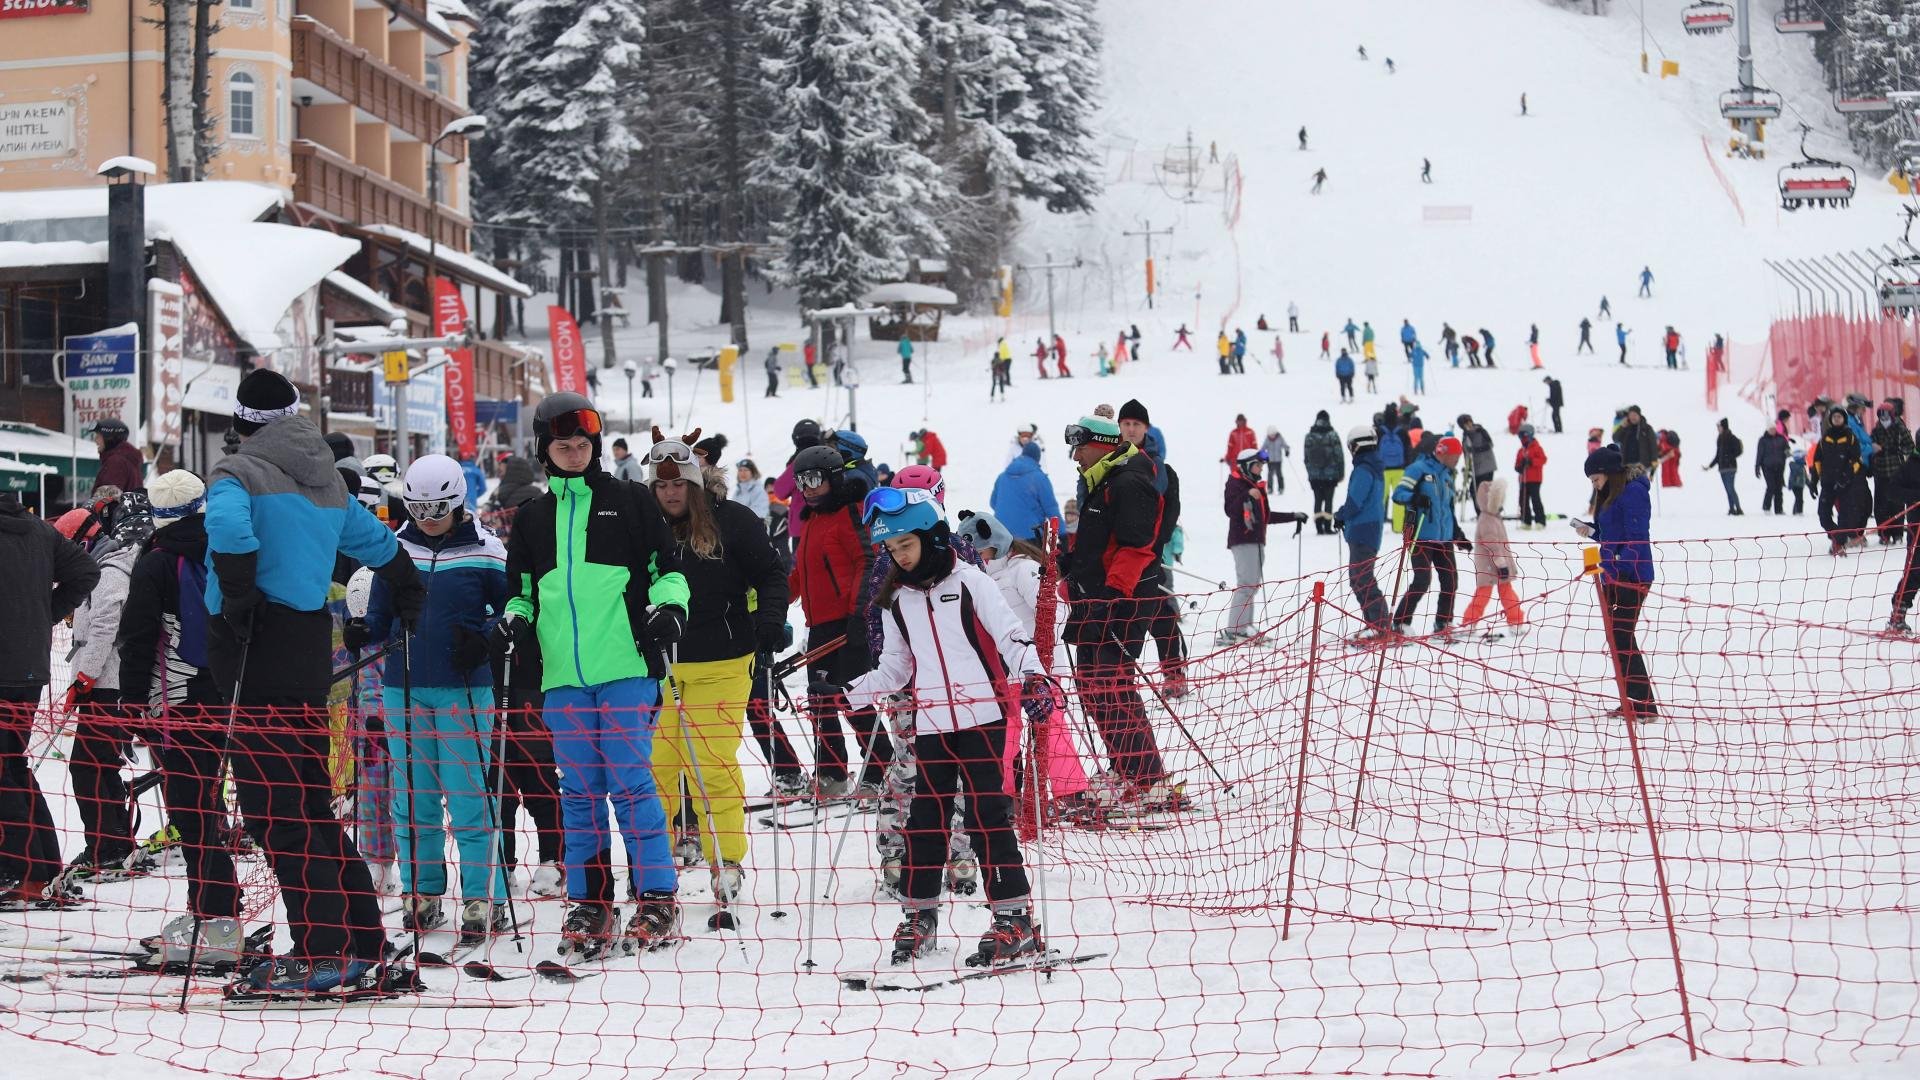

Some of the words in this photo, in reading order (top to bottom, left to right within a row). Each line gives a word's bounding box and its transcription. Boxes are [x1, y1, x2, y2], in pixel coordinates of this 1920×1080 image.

[24, 107, 66, 119] ARENA
[6, 123, 49, 136] HOTEL
[69, 380, 89, 391] BAR
[104, 379, 130, 389] FOOD
[75, 398, 94, 410] ALL
[99, 397, 126, 409] BEEF
[872, 527, 890, 537] UNIQA
